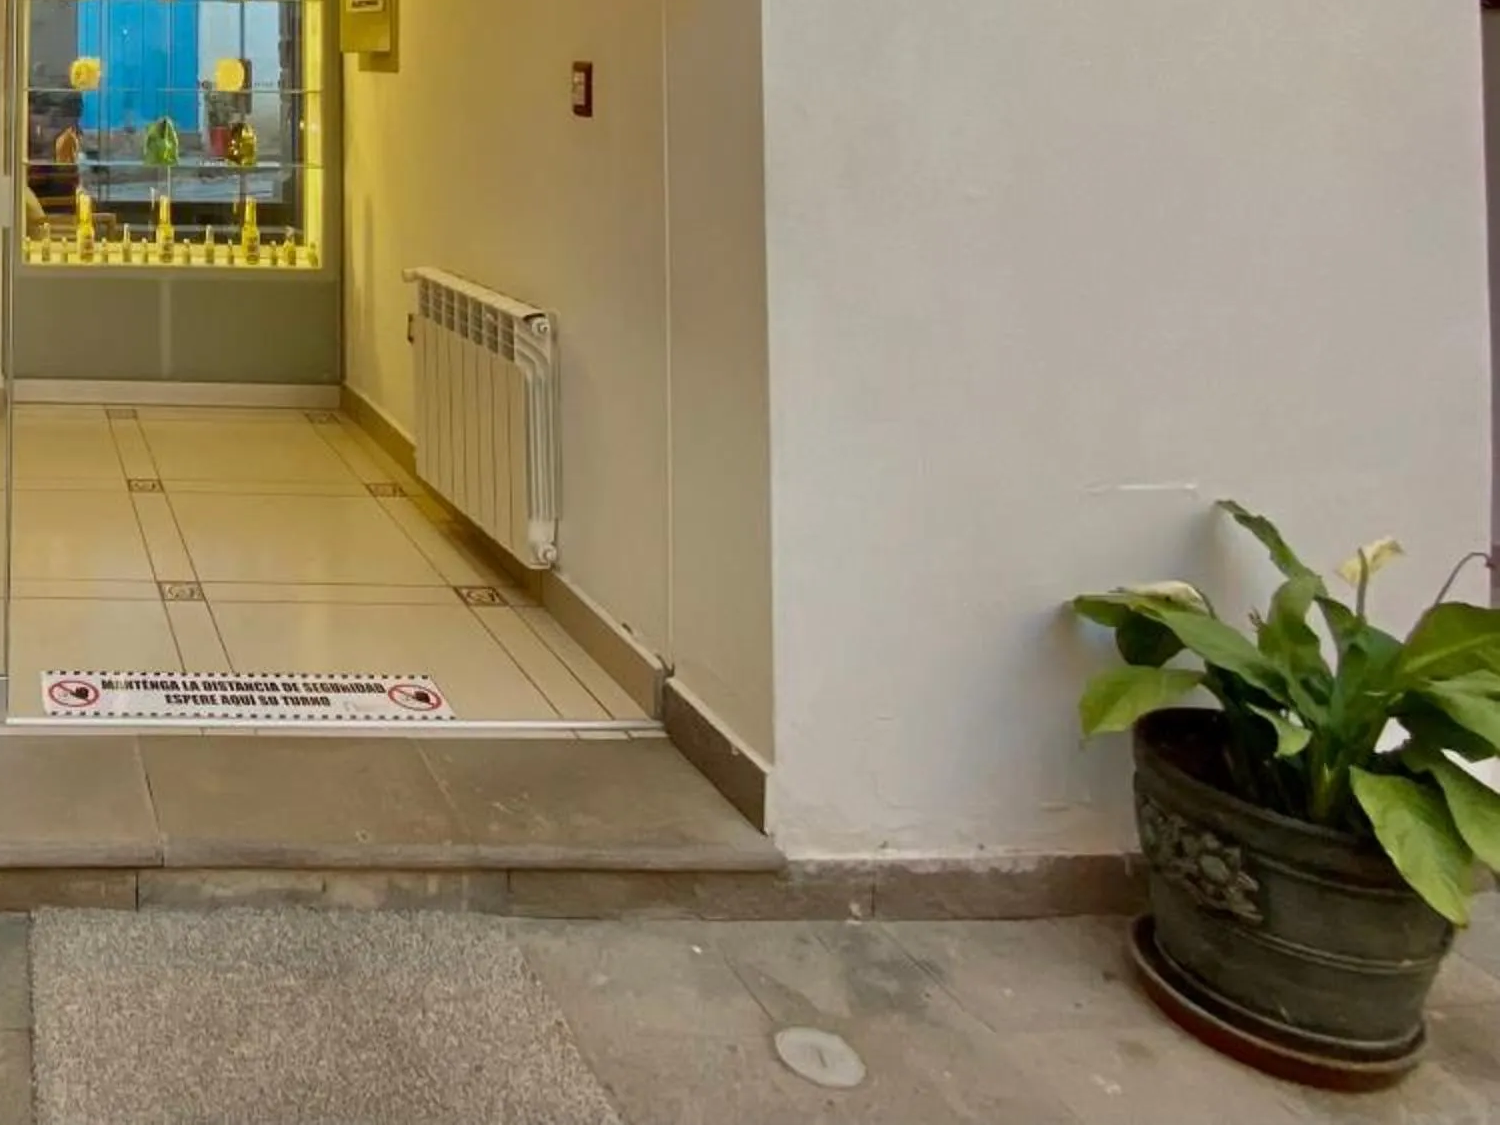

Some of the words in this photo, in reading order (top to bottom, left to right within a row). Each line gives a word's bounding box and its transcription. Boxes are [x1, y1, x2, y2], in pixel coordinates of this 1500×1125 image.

[182, 680, 200, 692] LA
[202, 681, 280, 693] DISTANCIA
[282, 682, 300, 693] DE
[302, 682, 386, 694] SEGURIDAD
[165, 694, 219, 705] ESPERE
[258, 695, 279, 706] SU
[282, 696, 331, 707] TURNO
